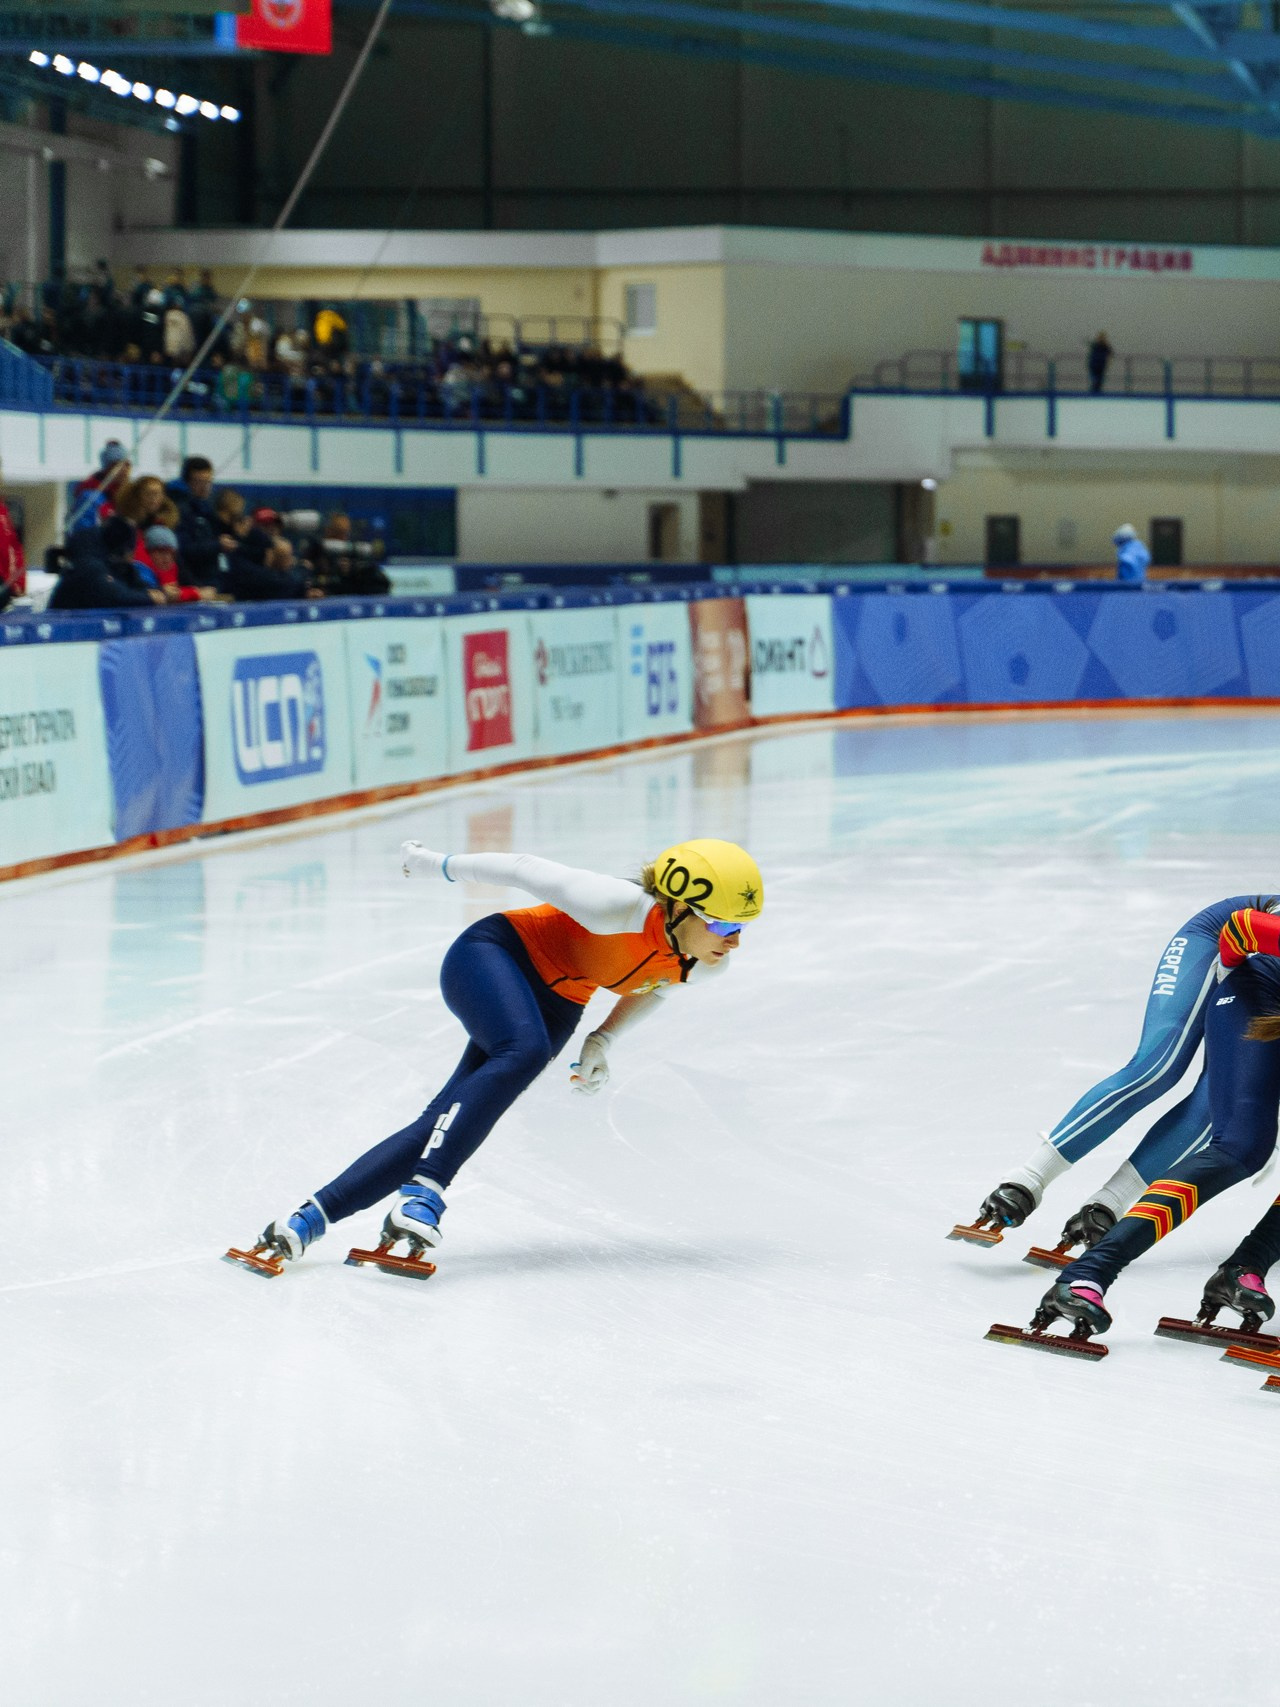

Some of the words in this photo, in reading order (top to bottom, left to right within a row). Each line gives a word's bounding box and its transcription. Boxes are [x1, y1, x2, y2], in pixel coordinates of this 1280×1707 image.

[981, 244, 1192, 271] АДМИНИСТРАЦИЯ
[660, 857, 714, 912] 102
[1152, 936, 1189, 996] СЕРГАЧ
